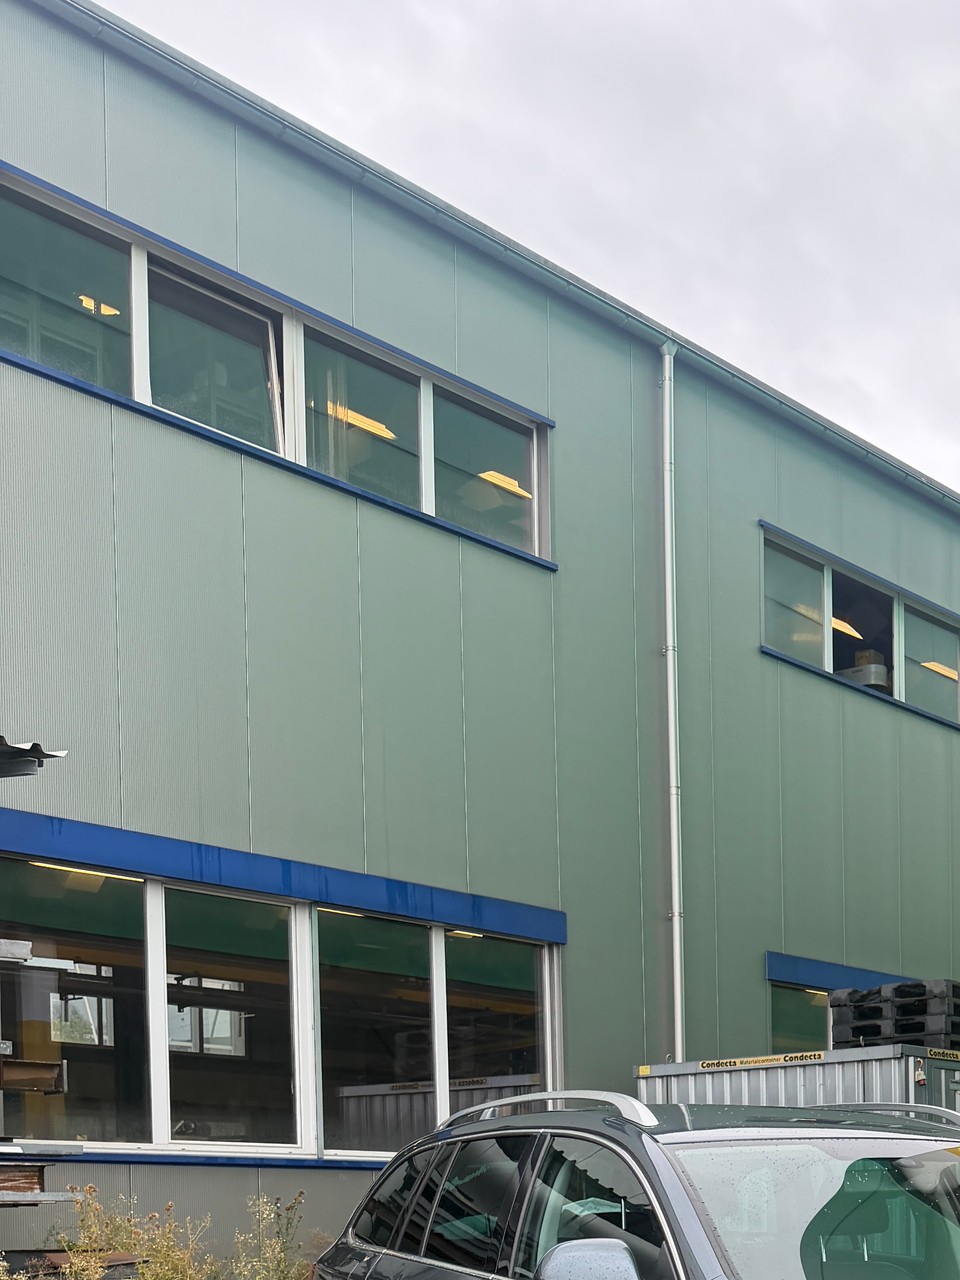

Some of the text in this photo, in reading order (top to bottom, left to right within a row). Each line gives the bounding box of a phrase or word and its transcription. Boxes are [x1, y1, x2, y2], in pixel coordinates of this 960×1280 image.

[700, 1060, 737, 1069] Condecta
[783, 1053, 822, 1063] Condecta
[928, 1049, 959, 1060] Condecta
